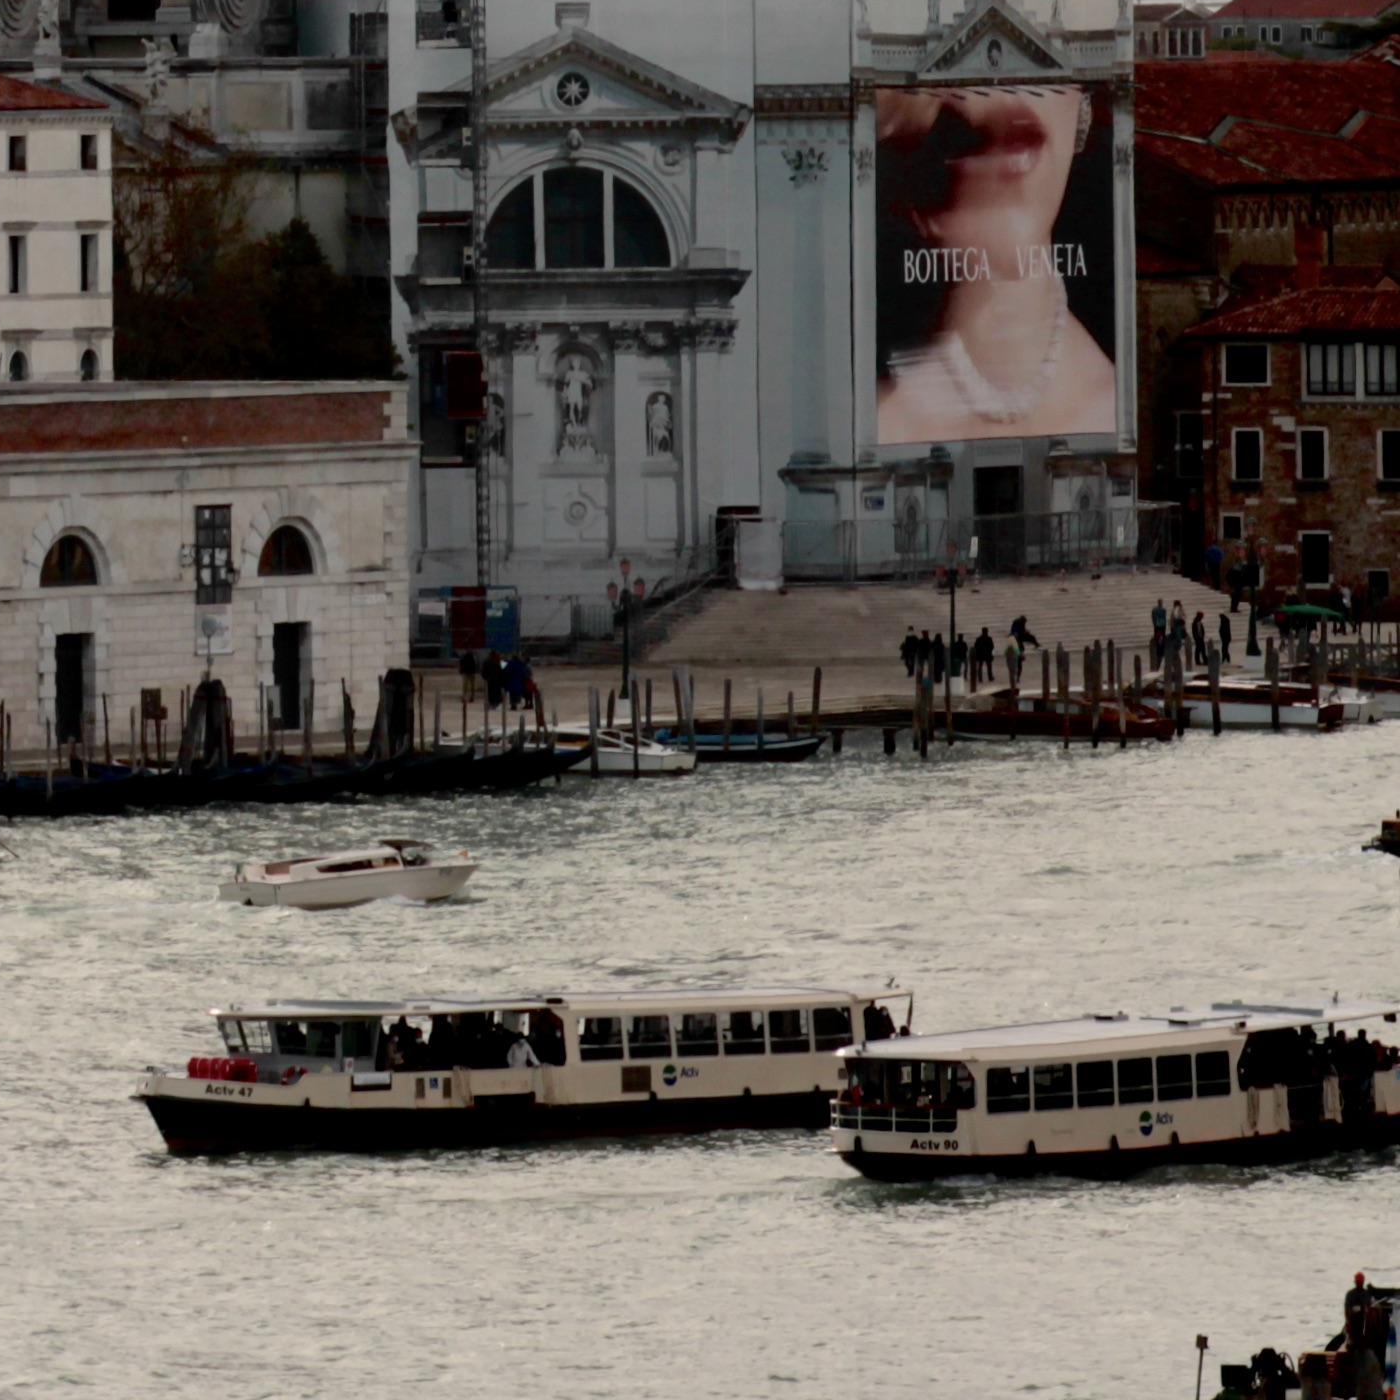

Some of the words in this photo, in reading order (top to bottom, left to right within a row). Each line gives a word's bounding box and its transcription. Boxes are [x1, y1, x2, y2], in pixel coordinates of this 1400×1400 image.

[903, 247, 991, 284] BOTTEGA
[1015, 243, 1088, 279] VENETA
[205, 1083, 234, 1096] Actv
[238, 1087, 253, 1098] 47
[910, 1138, 940, 1151] Actv
[943, 1139, 959, 1151] 90
